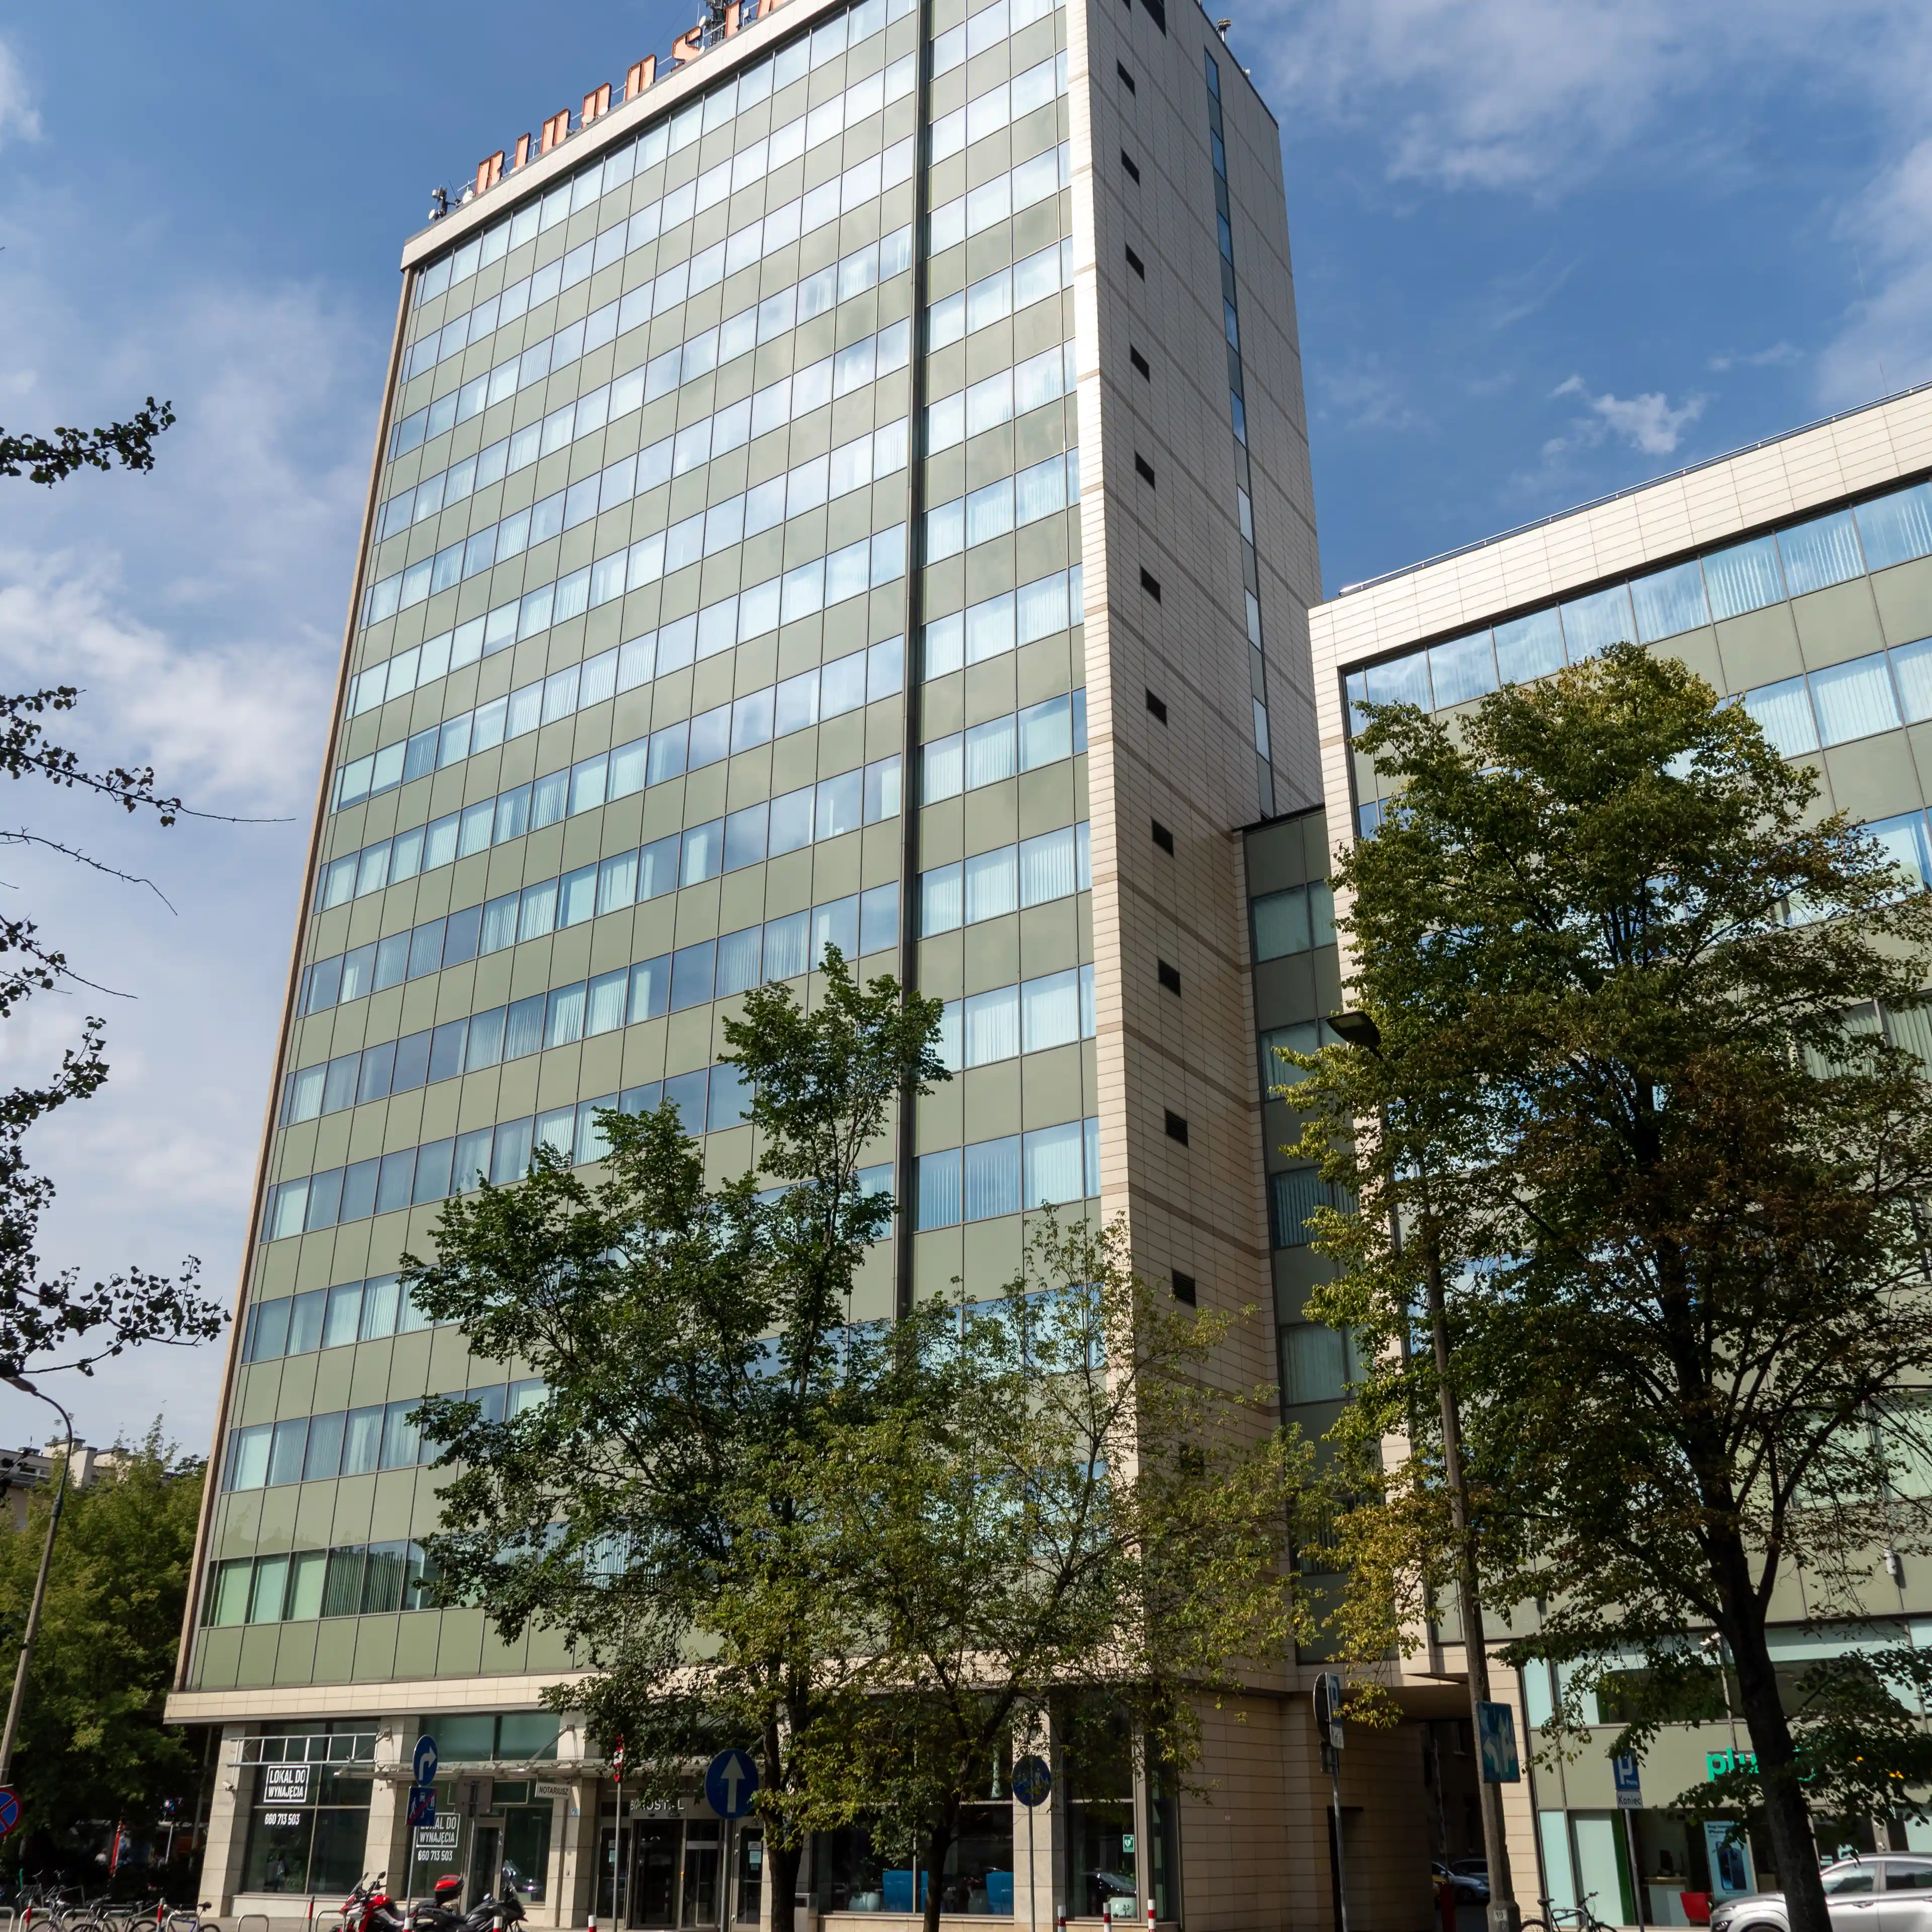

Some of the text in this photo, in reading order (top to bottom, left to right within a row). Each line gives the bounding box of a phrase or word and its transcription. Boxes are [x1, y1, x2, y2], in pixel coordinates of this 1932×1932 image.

[269, 1769, 306, 1784] LOKAL DO
[268, 1786, 303, 1800] WYNAJĘCIA
[539, 1786, 569, 1795] NOTARIUSZ
[1618, 1795, 1641, 1806] Koniec
[264, 1813, 301, 1825] 660 713 503
[446, 1817, 457, 1830] DO
[420, 1832, 454, 1845] WYNAJĘCIA
[418, 1849, 453, 1862] 660 713 503
